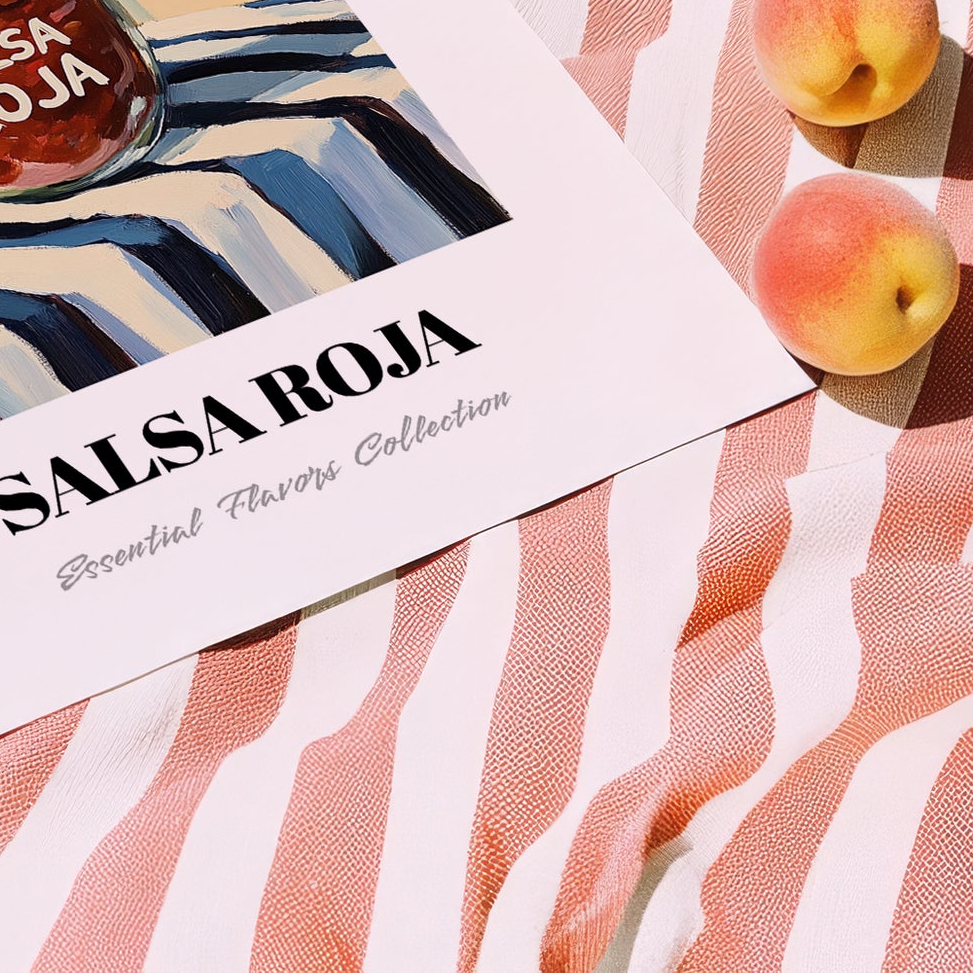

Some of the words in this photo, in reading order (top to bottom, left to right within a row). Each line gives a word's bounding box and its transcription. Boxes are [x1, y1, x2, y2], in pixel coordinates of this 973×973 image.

[248, 309, 483, 427] ROJA
[56, 507, 204, 591] Essential
[217, 458, 342, 520] Flavors
[355, 390, 513, 467] Collection
